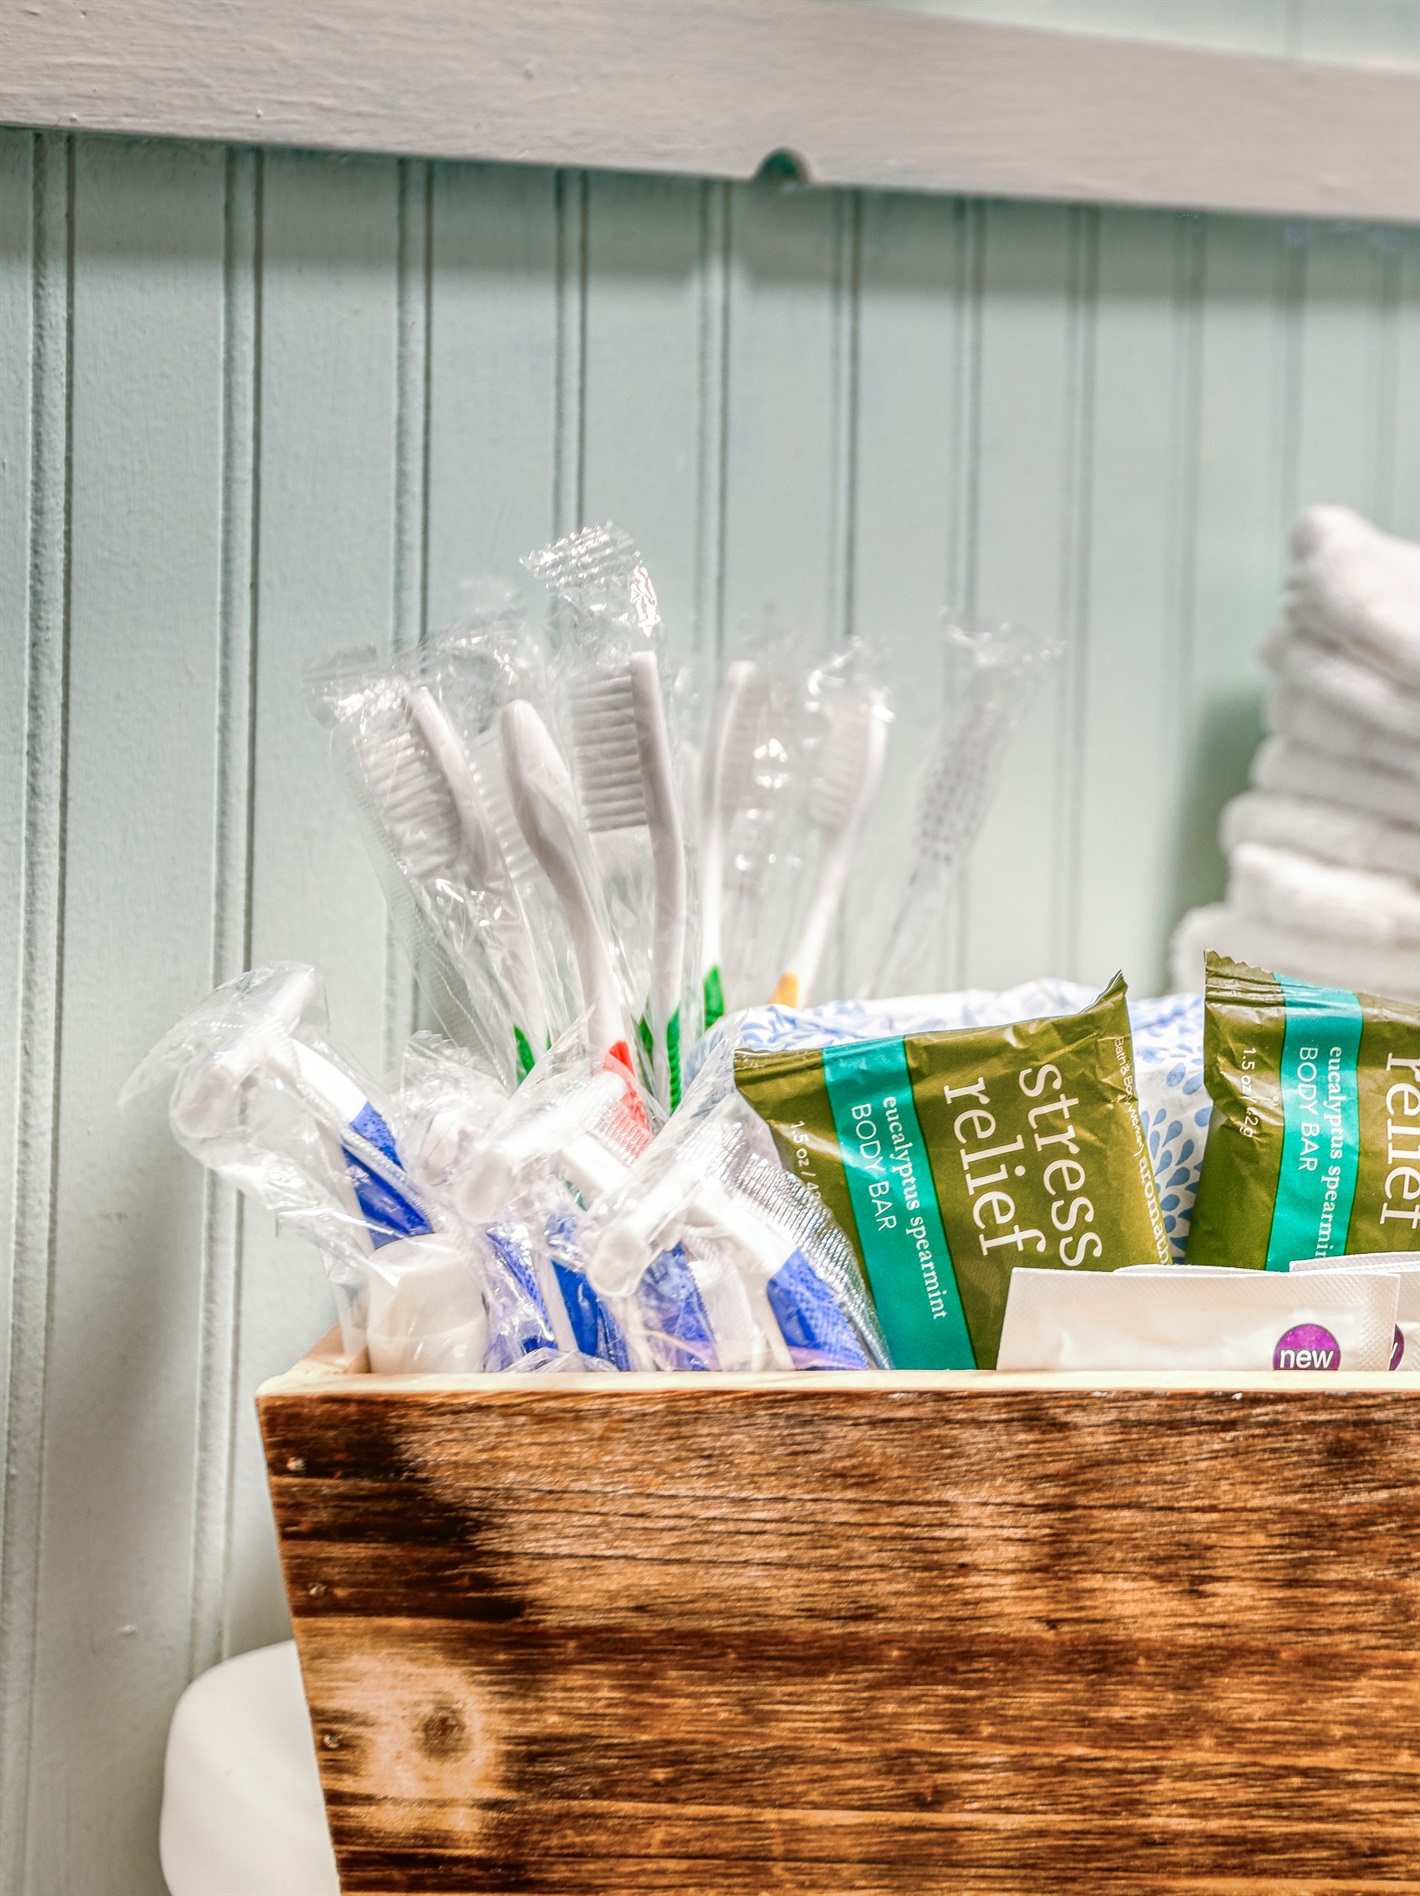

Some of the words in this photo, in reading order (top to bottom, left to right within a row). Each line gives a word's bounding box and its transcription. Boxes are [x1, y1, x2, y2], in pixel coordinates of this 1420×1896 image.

[1115, 1037, 1127, 1065] Bath
[1241, 1047, 1257, 1070] 1.5
[1240, 1074, 1252, 1094] oz
[1296, 1047, 1319, 1116] BODY
[1322, 1046, 1347, 1160] eucalyptus
[790, 1120, 809, 1144] 1.5
[852, 1103, 886, 1173] BODY
[1298, 1123, 1320, 1171] BAR
[796, 1148, 810, 1167] oz
[944, 1076, 1047, 1256] relief
[1019, 1064, 1103, 1267] stress
[868, 1180, 897, 1231] BAR
[883, 1096, 920, 1211] eucalyptus
[905, 1212, 948, 1319] spearmint
[1279, 1349, 1335, 1369] new
